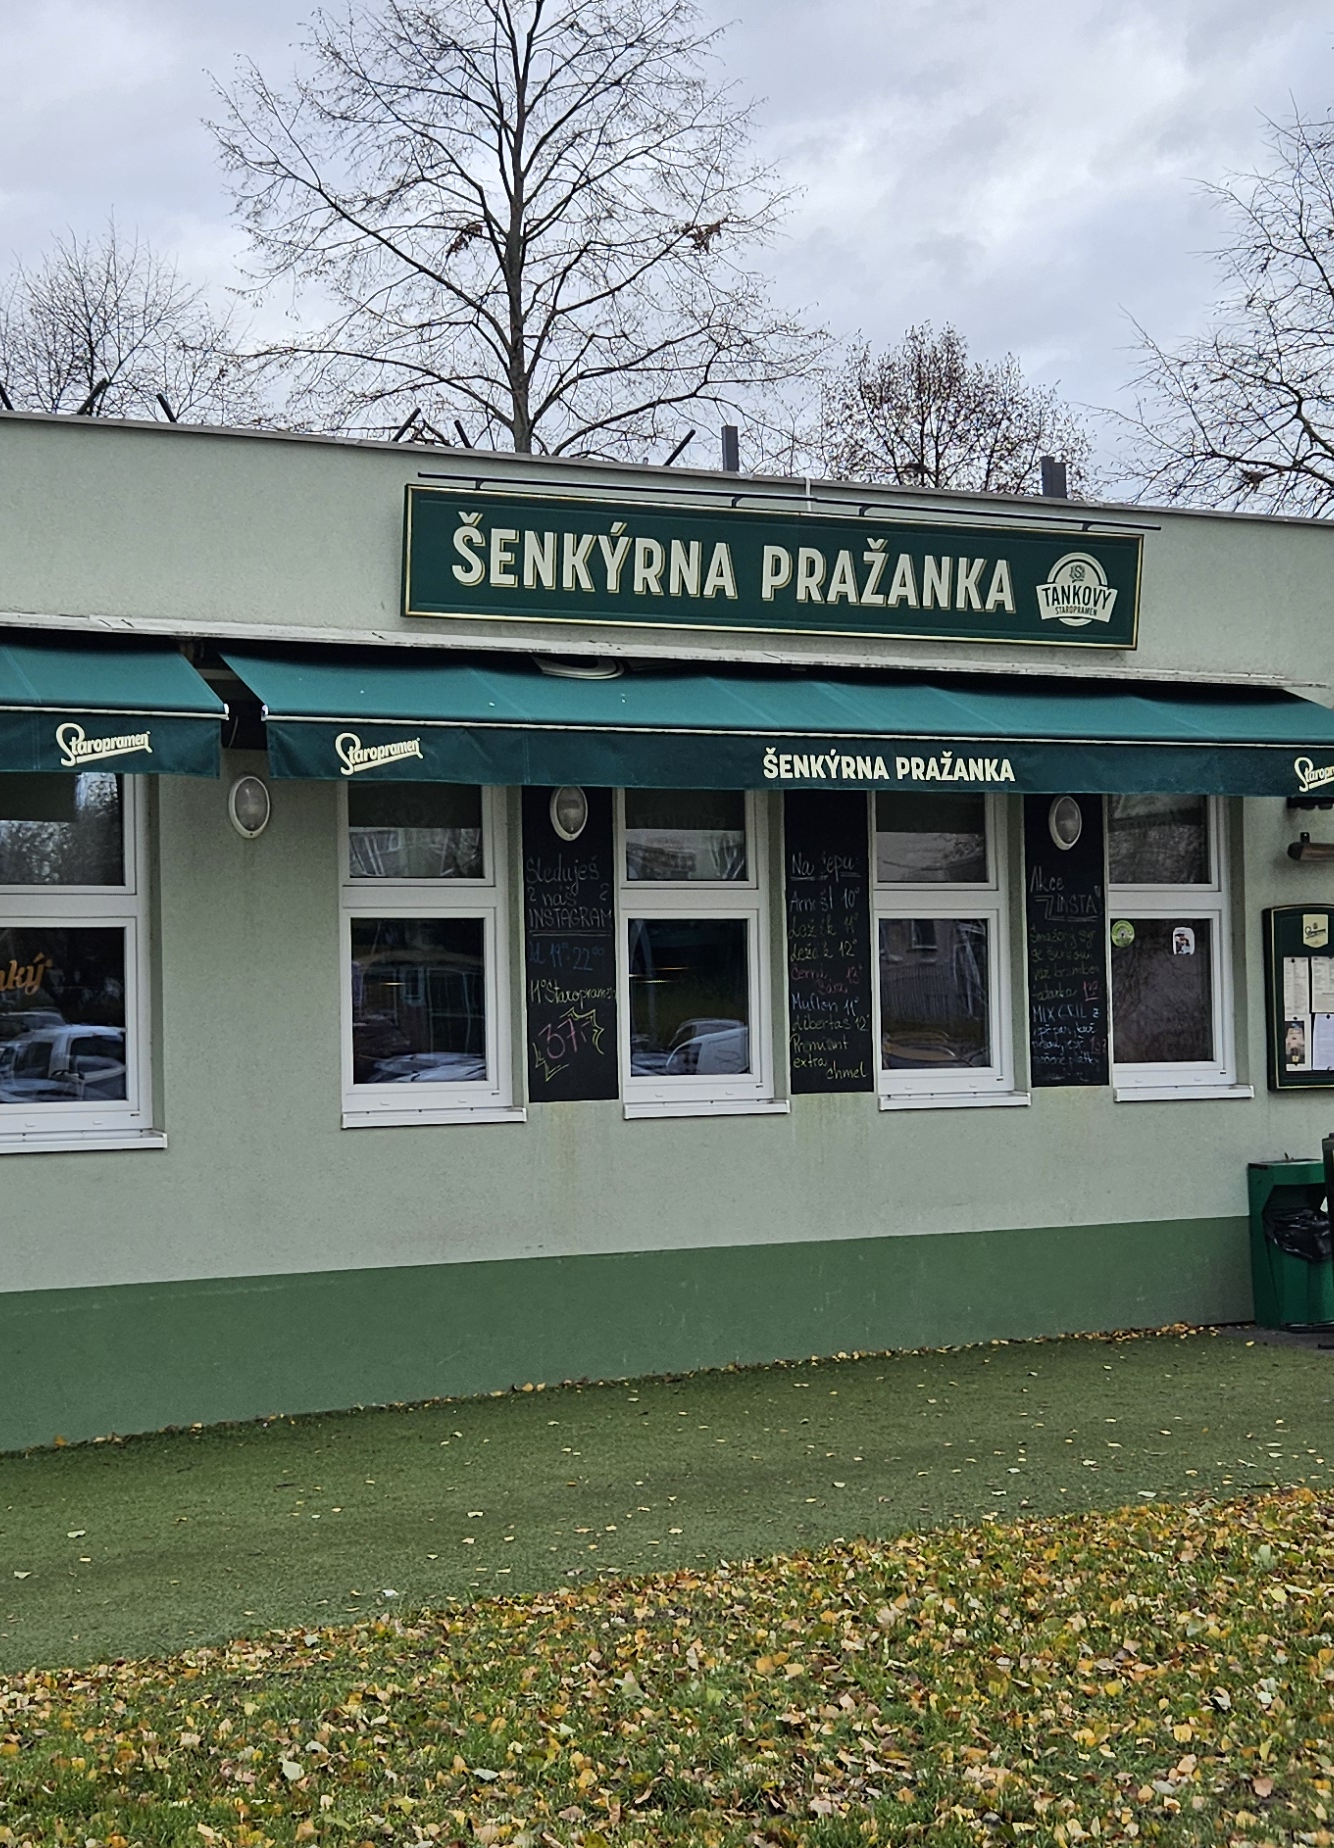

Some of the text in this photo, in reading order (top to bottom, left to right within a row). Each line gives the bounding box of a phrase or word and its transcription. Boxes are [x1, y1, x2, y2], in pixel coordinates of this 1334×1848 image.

[451, 511, 1017, 613] ŠENKÝRNA PRAŽANKA
[1055, 605, 1098, 616] STAROPRAMEN
[55, 722, 153, 767] Staropramen
[335, 732, 424, 776] Staropramen
[762, 747, 1016, 783] ŠENKÝRNA PRAŽANKA
[528, 906, 613, 929] INSTAGRAM
[793, 1054, 827, 1068] extra
